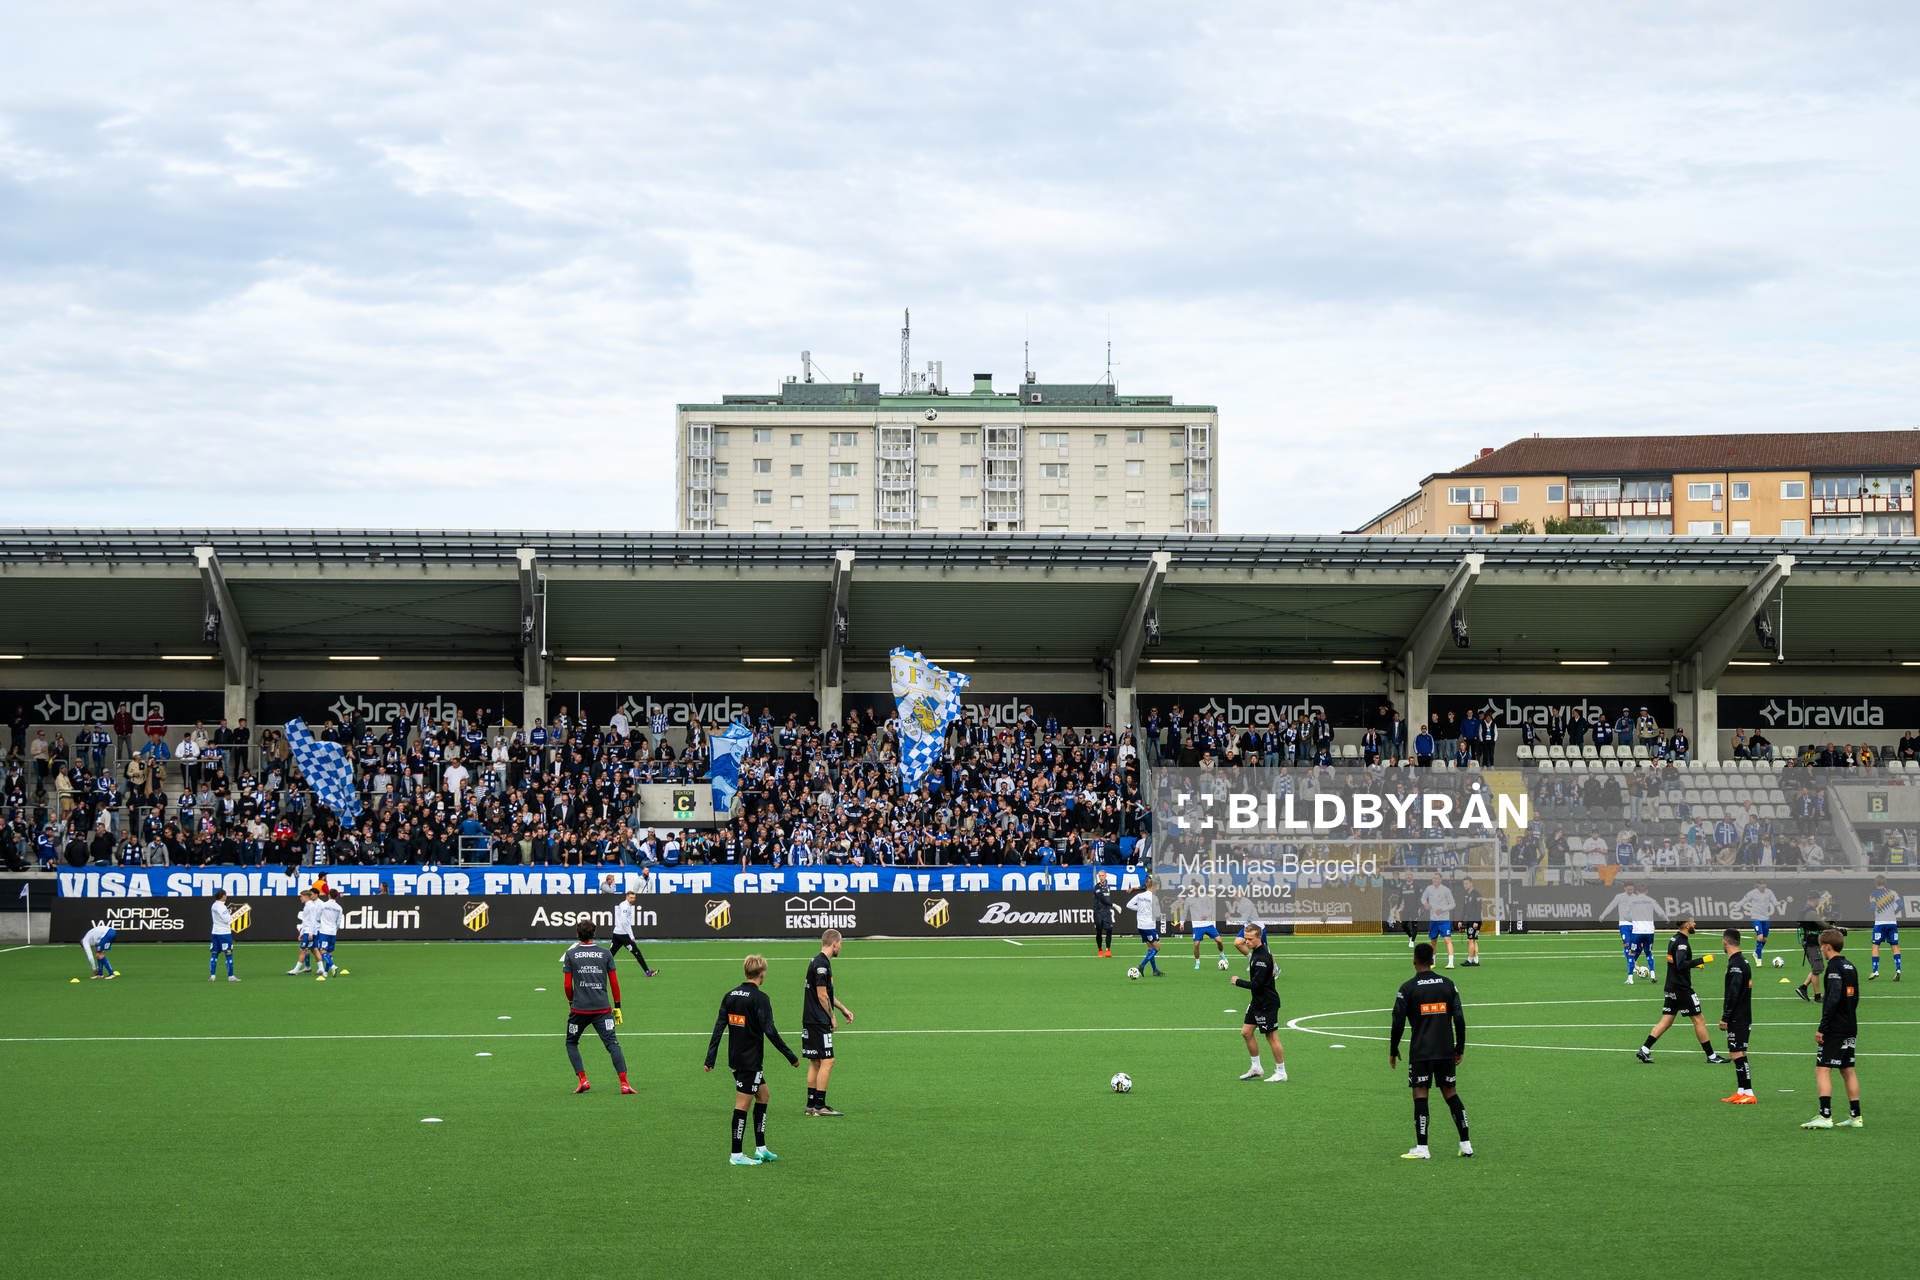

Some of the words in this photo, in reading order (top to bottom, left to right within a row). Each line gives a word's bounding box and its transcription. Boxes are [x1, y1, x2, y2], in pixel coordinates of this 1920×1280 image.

[962, 697, 1034, 724] avida
[1788, 699, 1884, 726] bravida
[677, 796, 690, 811] C
[1872, 798, 1883, 812] B
[60, 872, 153, 897] VISA
[393, 865, 470, 896] FÖR
[107, 908, 169, 919] NORDIC
[531, 905, 658, 927] Assemlin
[786, 911, 856, 929] EKSJÖHUS
[978, 902, 1058, 924] Boom
[91, 919, 184, 930] WELLNESS
